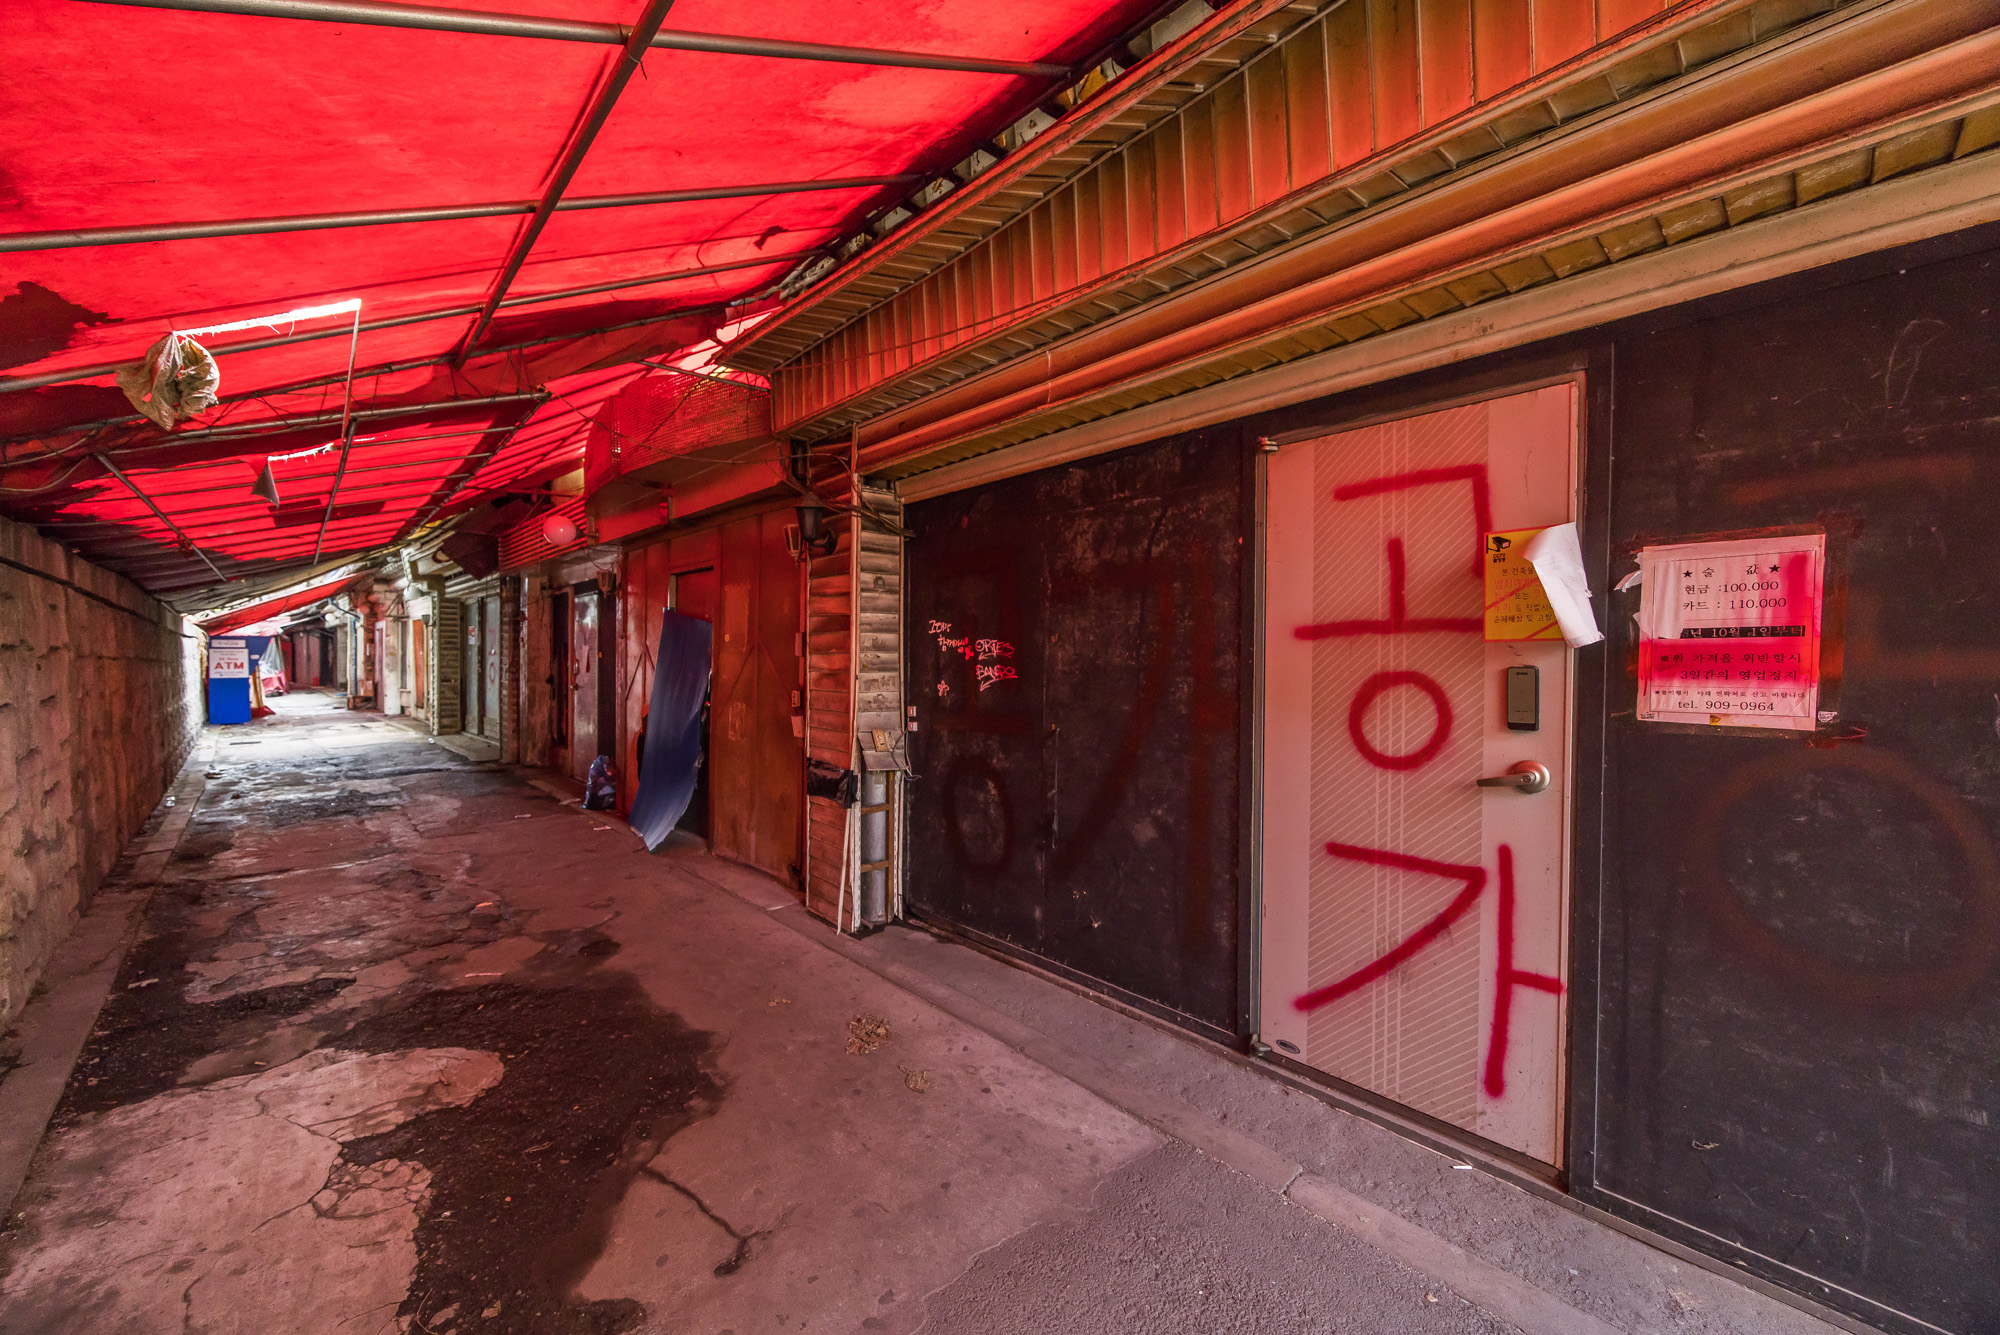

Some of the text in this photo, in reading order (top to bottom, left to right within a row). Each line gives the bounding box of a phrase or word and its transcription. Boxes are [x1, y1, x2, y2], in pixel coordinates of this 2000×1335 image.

[1746, 564, 1759, 575] 값
[1684, 584, 1711, 595] 현금
[1683, 600, 1710, 611] 카드
[214, 661, 244, 670] ATM
[1681, 669, 1797, 681] 3일간의 영업정지
[1678, 700, 1775, 711] tel. 909-0964
[1293, 462, 1566, 1098] 공가
